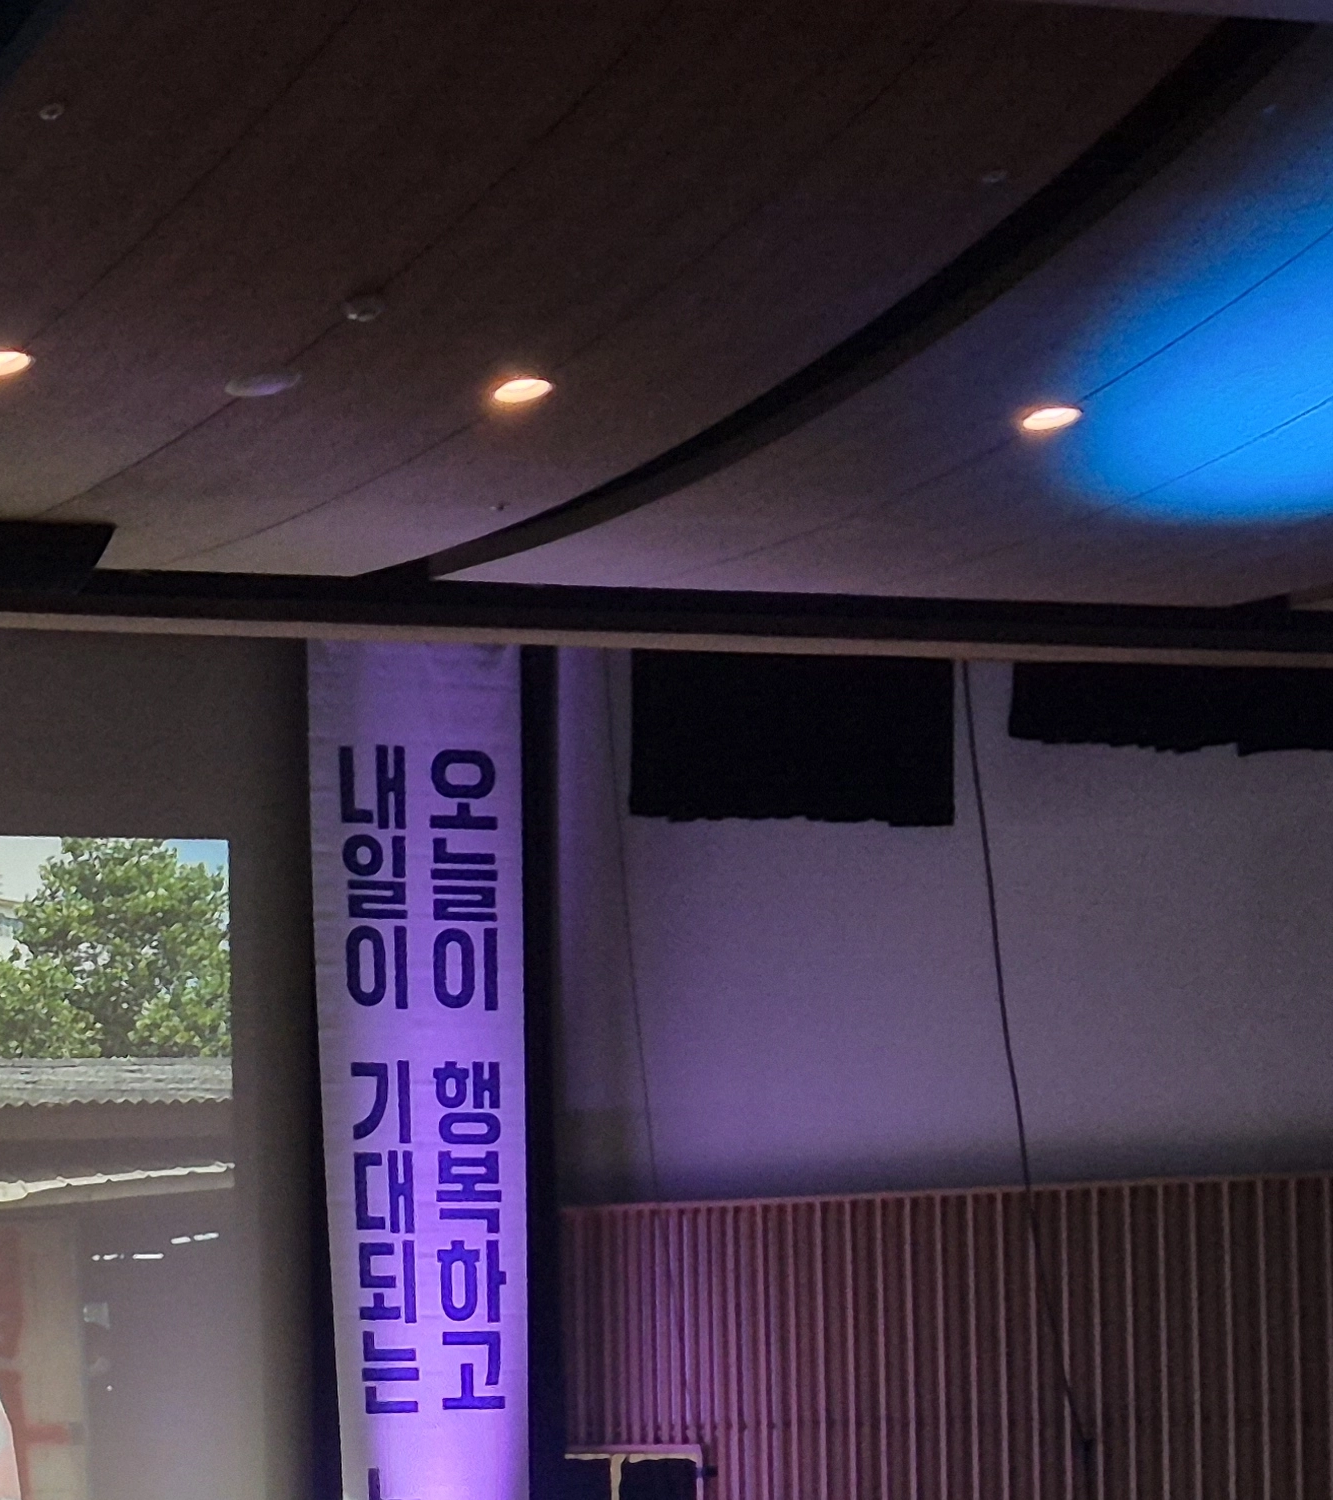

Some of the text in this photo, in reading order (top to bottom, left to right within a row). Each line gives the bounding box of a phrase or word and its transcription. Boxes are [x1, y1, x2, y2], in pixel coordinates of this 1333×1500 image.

[338, 744, 409, 1010] 내일이
[350, 1059, 420, 1414] 기대되는
[429, 748, 507, 1411] 오늘이 행복하고
